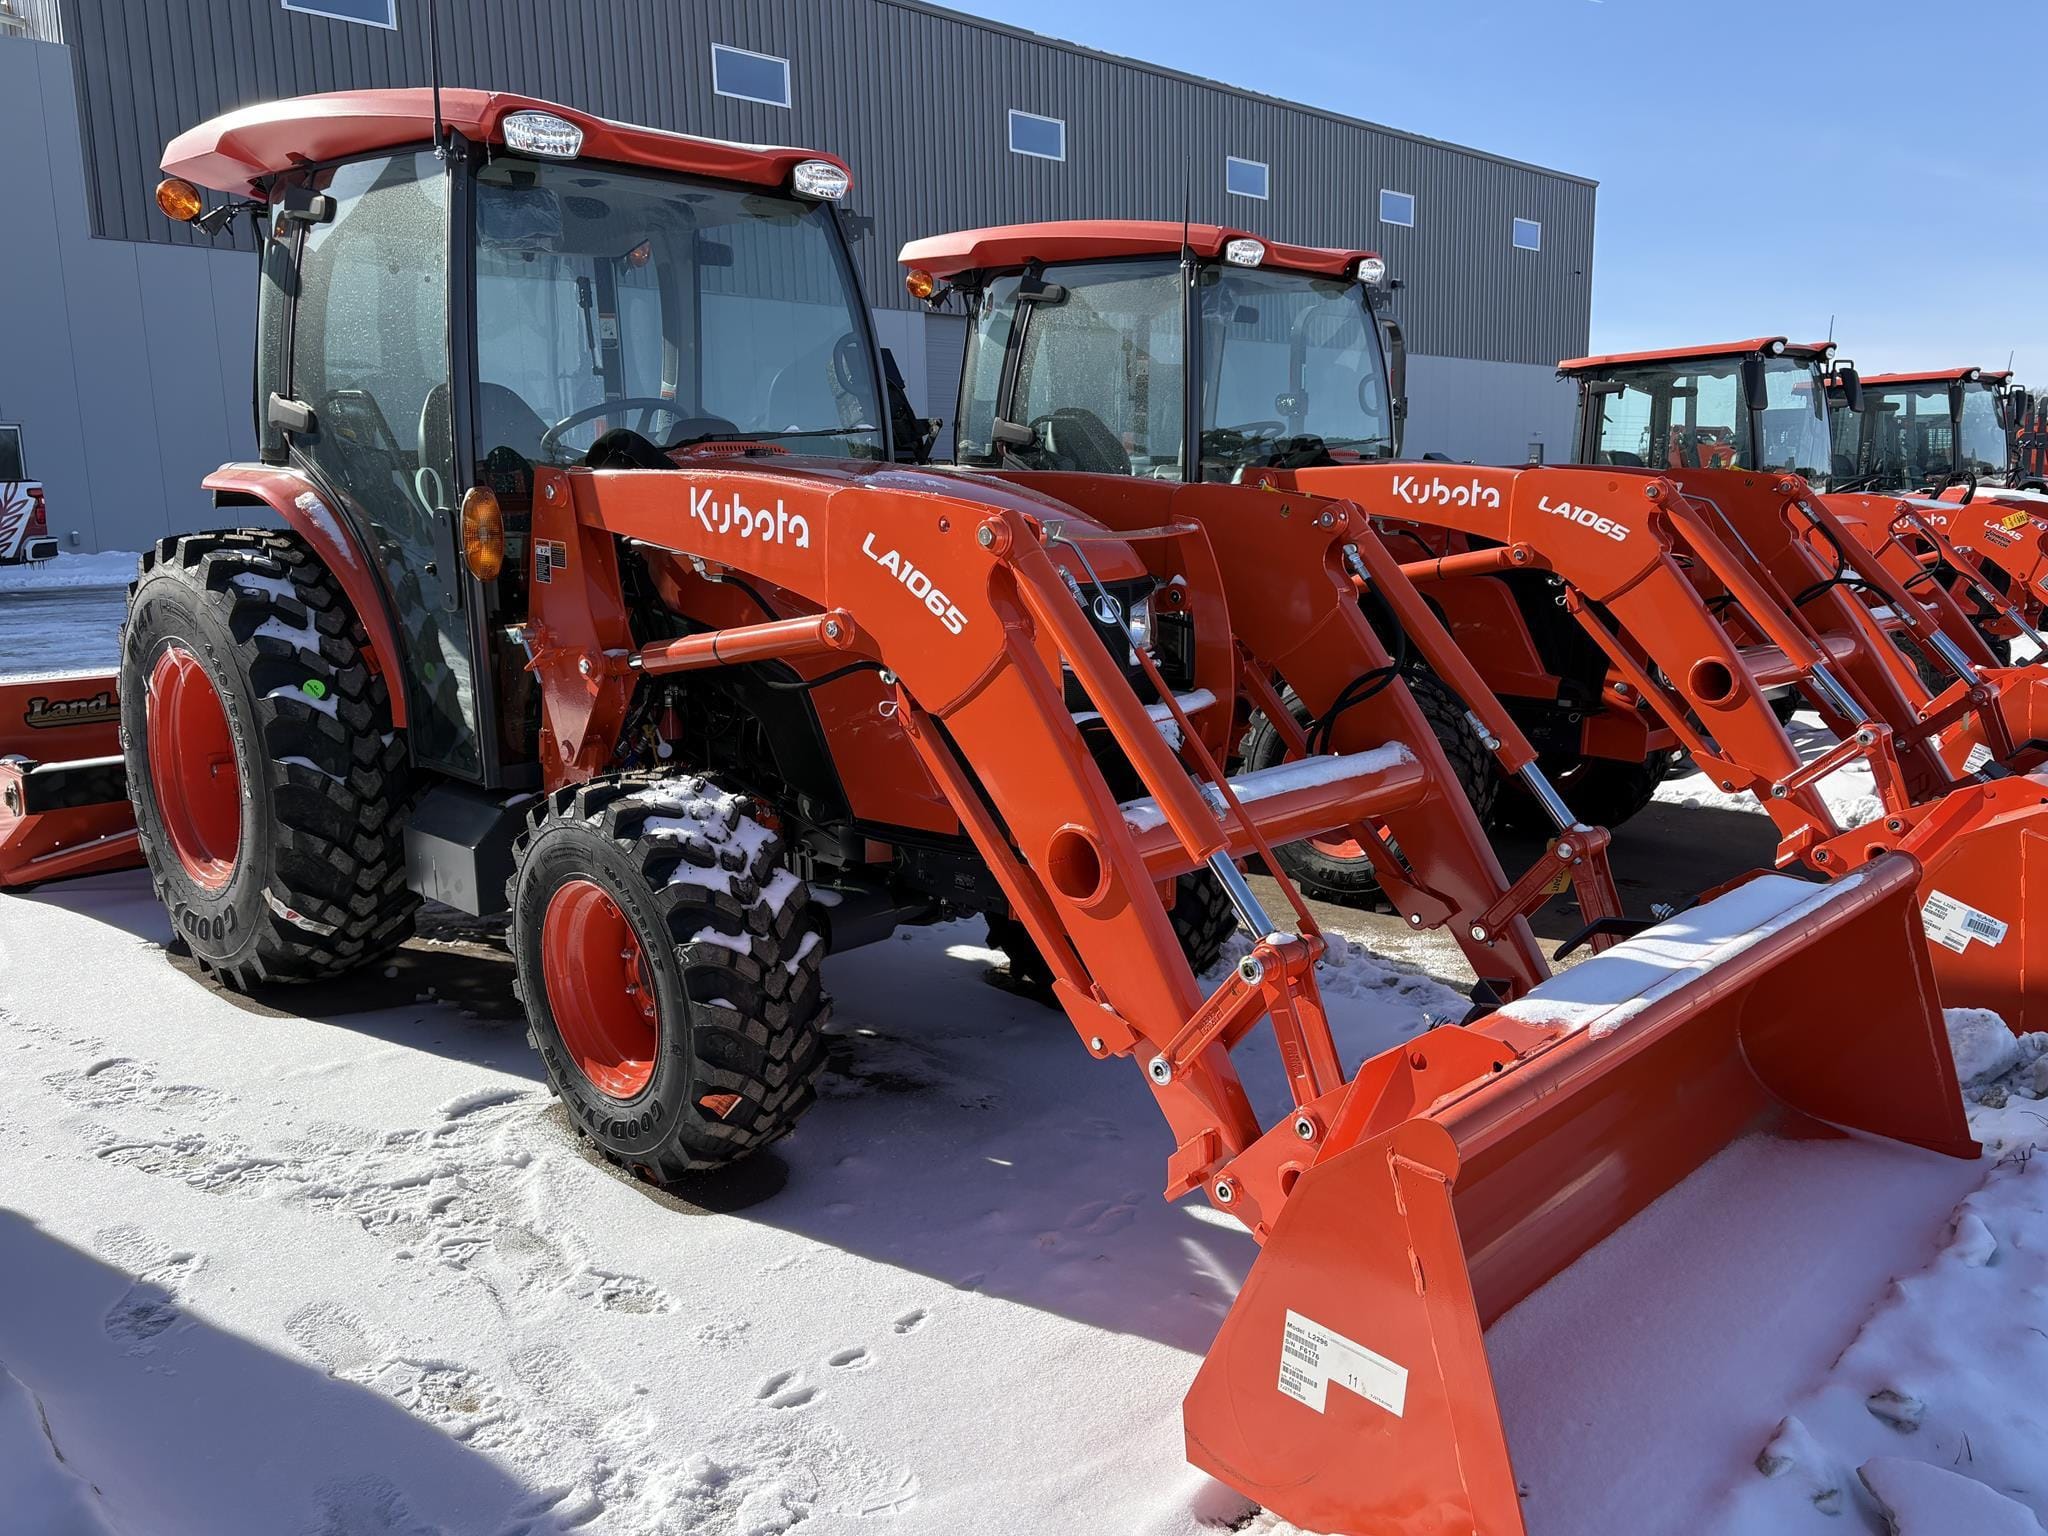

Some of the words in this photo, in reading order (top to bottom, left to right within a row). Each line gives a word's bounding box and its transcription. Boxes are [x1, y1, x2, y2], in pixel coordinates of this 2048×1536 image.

[1392, 475, 1500, 508] Kubota
[690, 486, 809, 548] Kubota
[1538, 496, 1630, 542] LA1065
[1983, 520, 2024, 541] LA545
[862, 532, 968, 635] LA1065
[27, 693, 110, 721] Land
[543, 1045, 664, 1140] GOODYEAR
[1286, 1321, 1305, 1335] Model
[1307, 1331, 1329, 1347] L2296
[1348, 1373, 1358, 1389] 11
